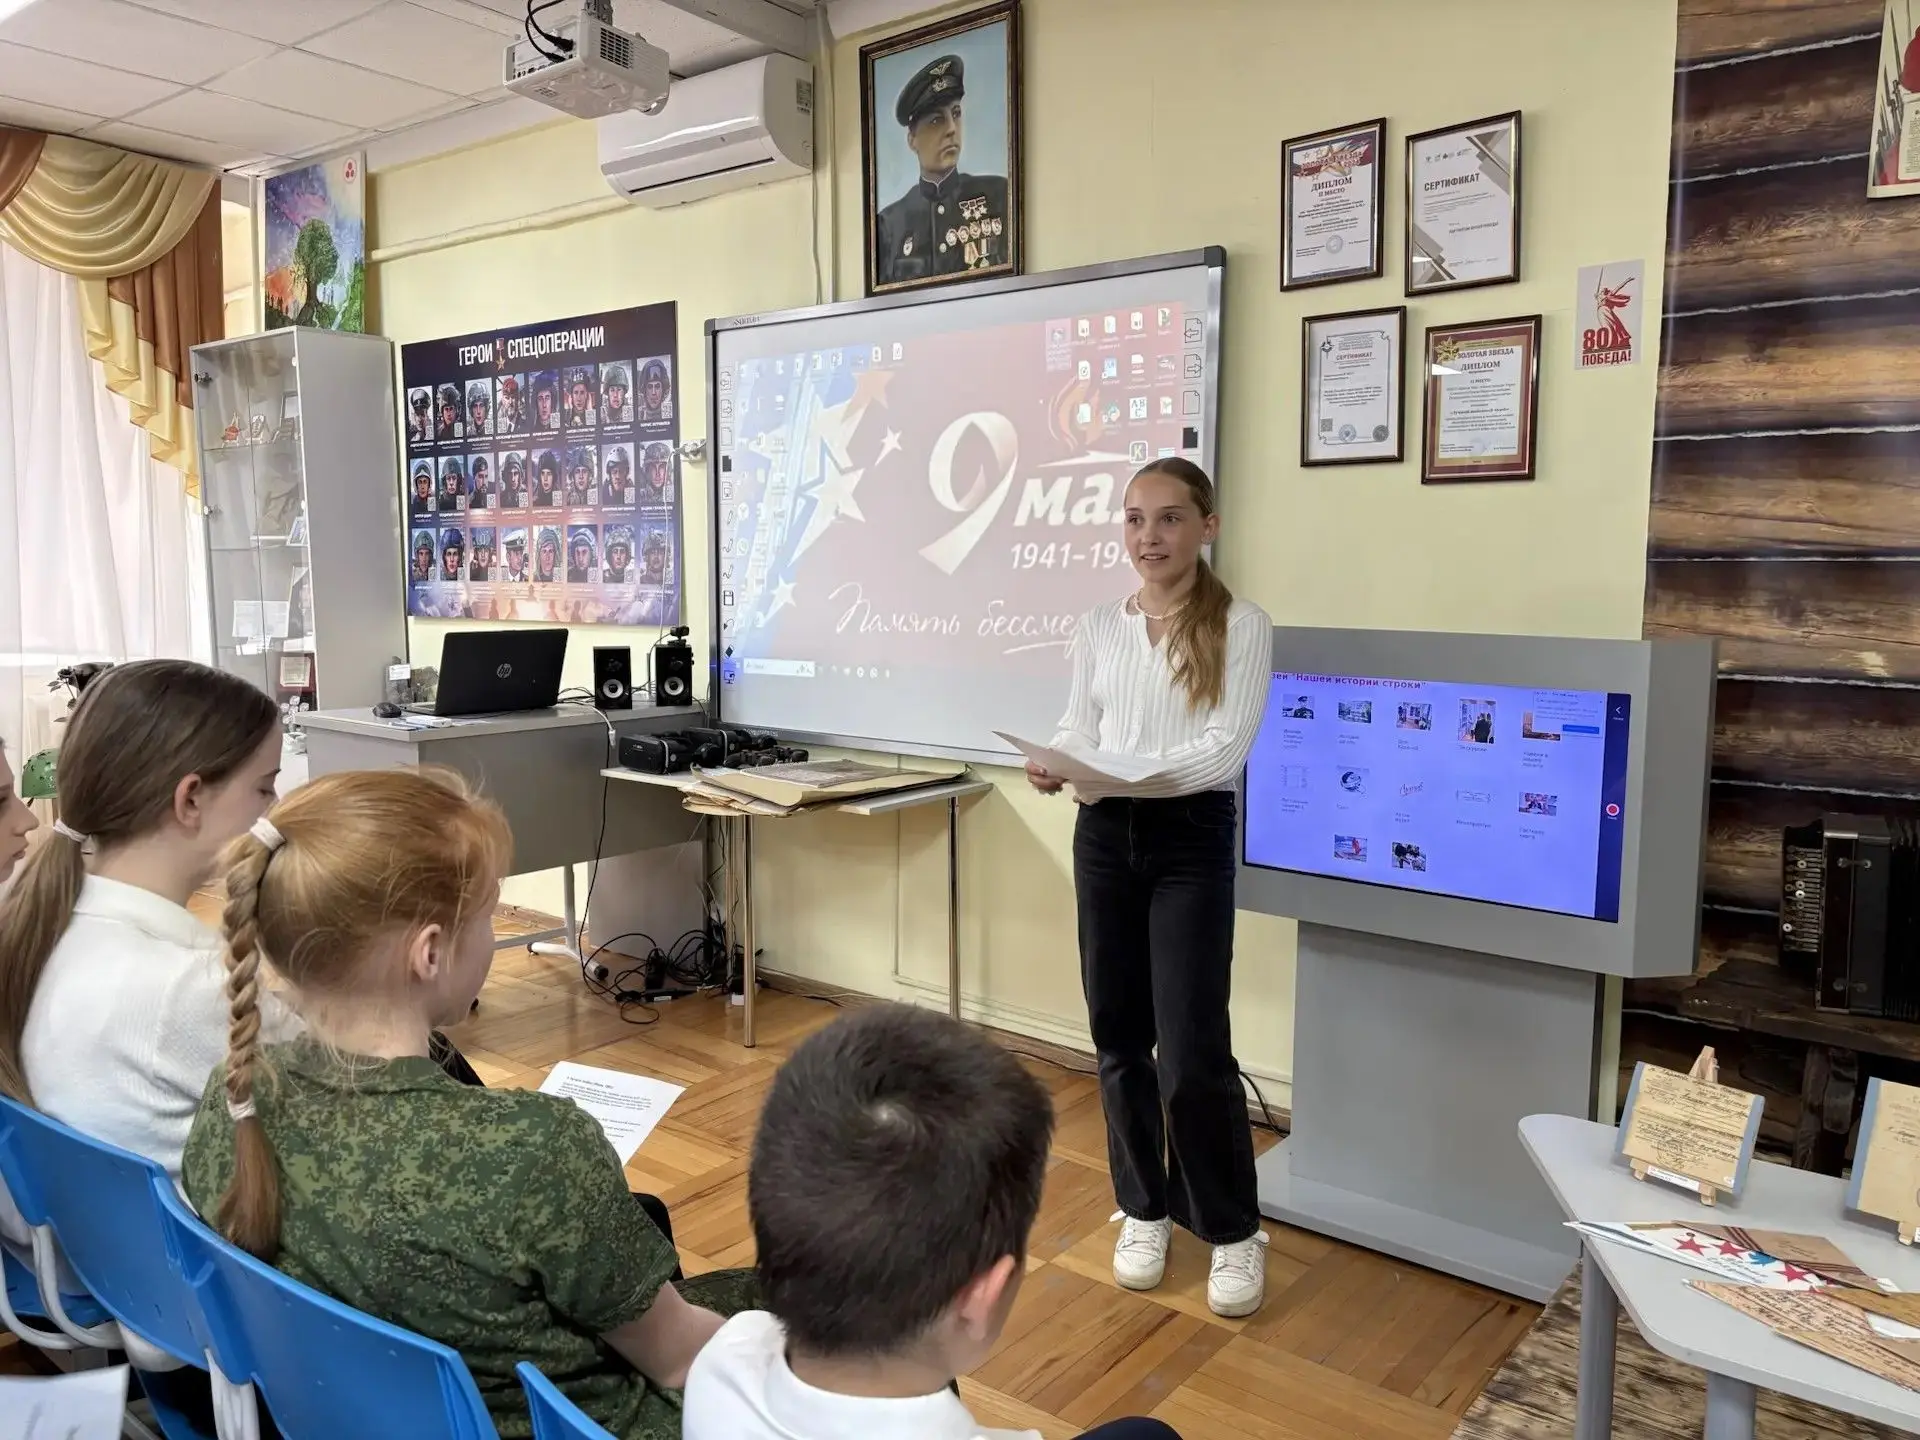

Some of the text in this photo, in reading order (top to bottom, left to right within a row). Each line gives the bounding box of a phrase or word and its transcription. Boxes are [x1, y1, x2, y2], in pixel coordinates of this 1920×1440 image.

[1311, 176, 1353, 193] ДИПЛОМ
[1424, 172, 1480, 192] СЕРТИФИКАТ
[1324, 187, 1346, 197] МЕСТО
[458, 325, 605, 367] ГЕРОИ СПЕЦОПЕРАЦИИ
[1583, 327, 1610, 350] 80
[1336, 351, 1373, 361] СЕРТИФИКАТ
[1488, 347, 1514, 357] ЗВЕЗДА
[1582, 350, 1632, 366] ПОБЕДА!
[1460, 360, 1501, 371] ДИПЛОМ
[918, 412, 1018, 576] 9
[1013, 472, 1126, 527] ма
[828, 581, 960, 635] Память
[1335, 676, 1379, 687] истории
